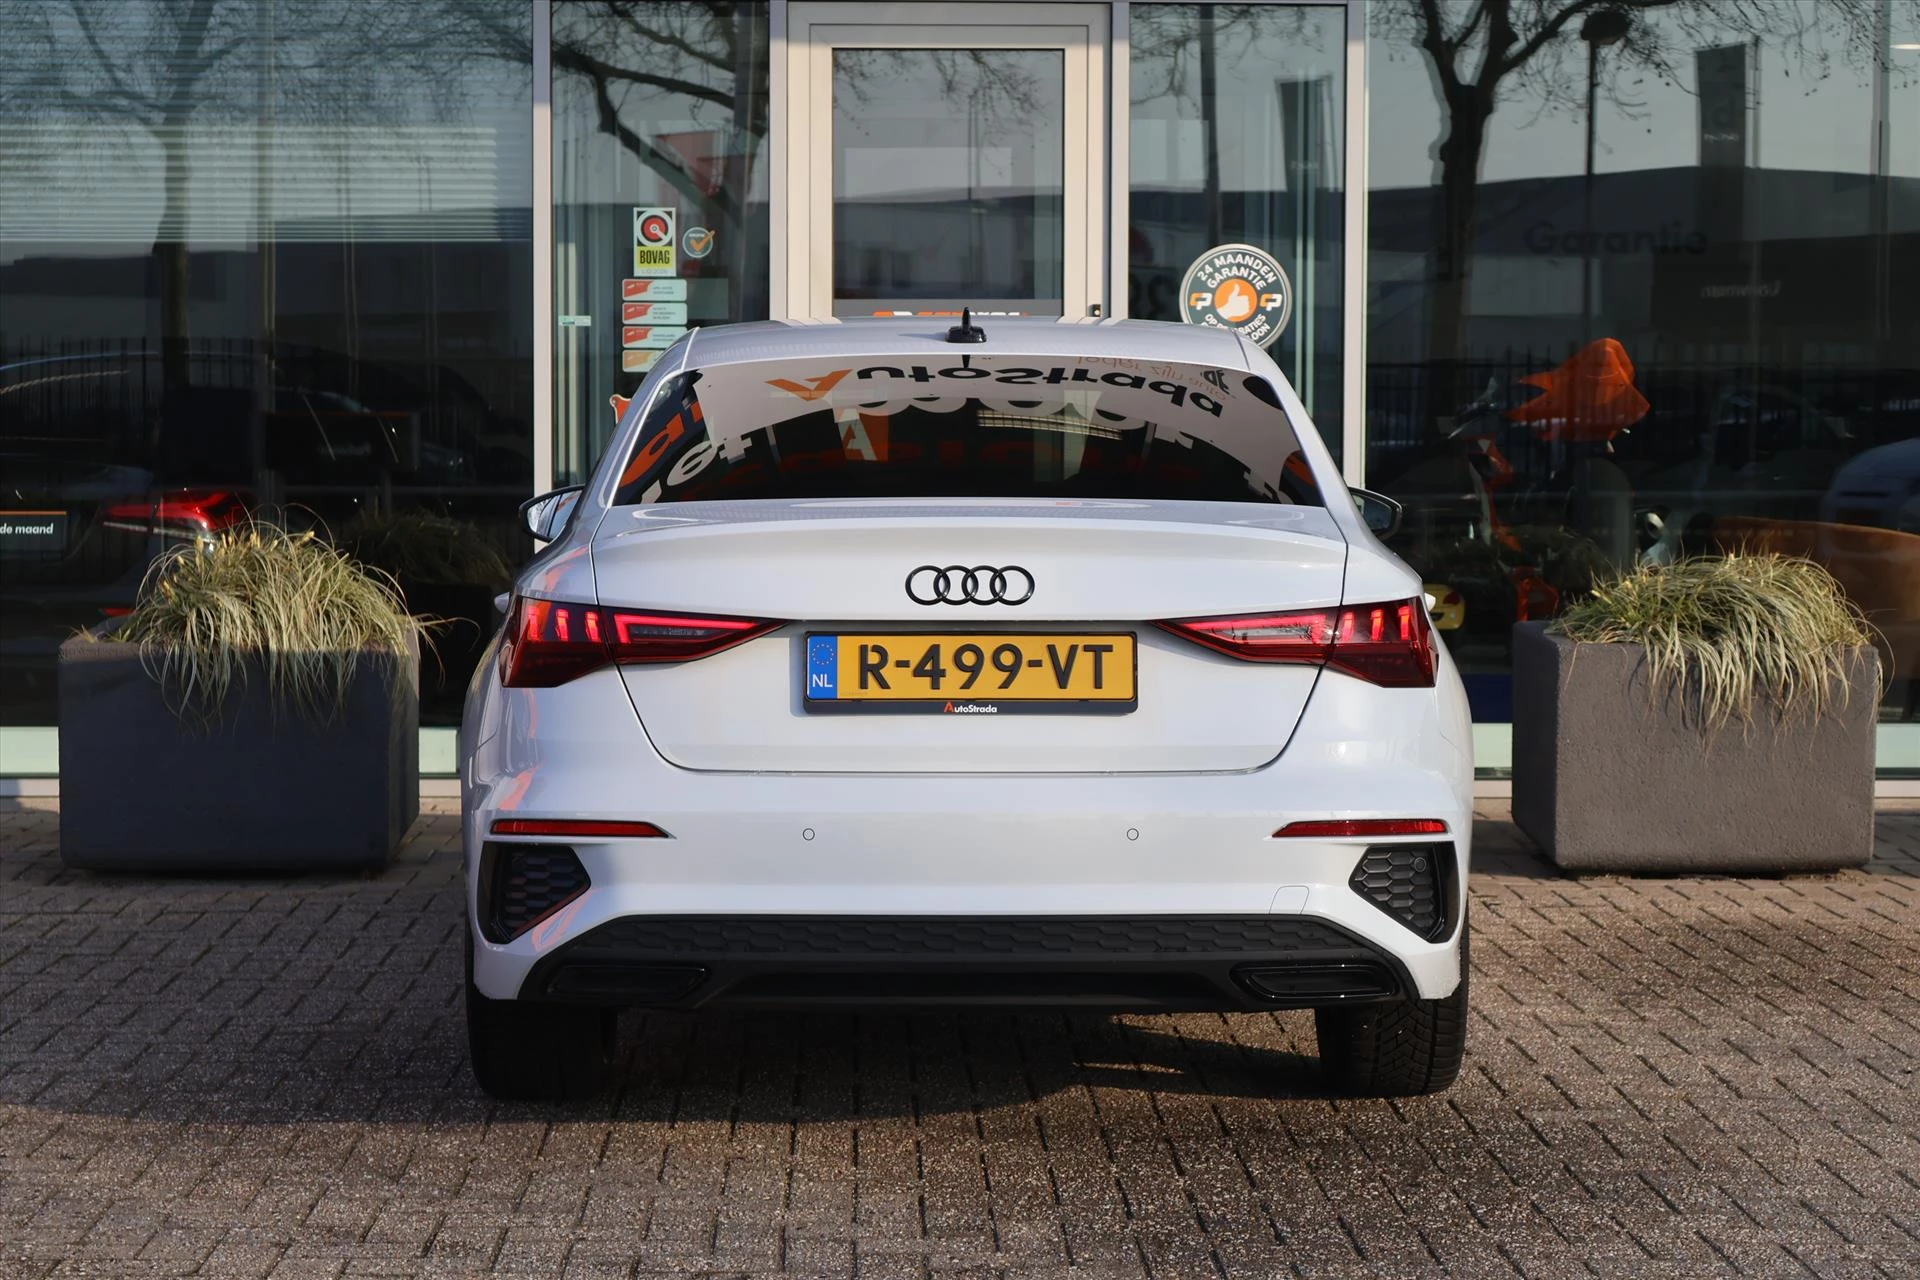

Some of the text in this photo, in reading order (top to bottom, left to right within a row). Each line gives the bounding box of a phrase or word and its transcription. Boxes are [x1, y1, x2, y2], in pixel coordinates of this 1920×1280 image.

[640, 250, 670, 265] BOVAG
[1197, 253, 1277, 284] 24 MAANDEN
[1207, 265, 1267, 290] GARANTIE
[0, 522, 54, 535] de maand
[858, 643, 1114, 690] R-499-VT
[812, 673, 833, 688] NL
[944, 701, 998, 713] AutoStrada
